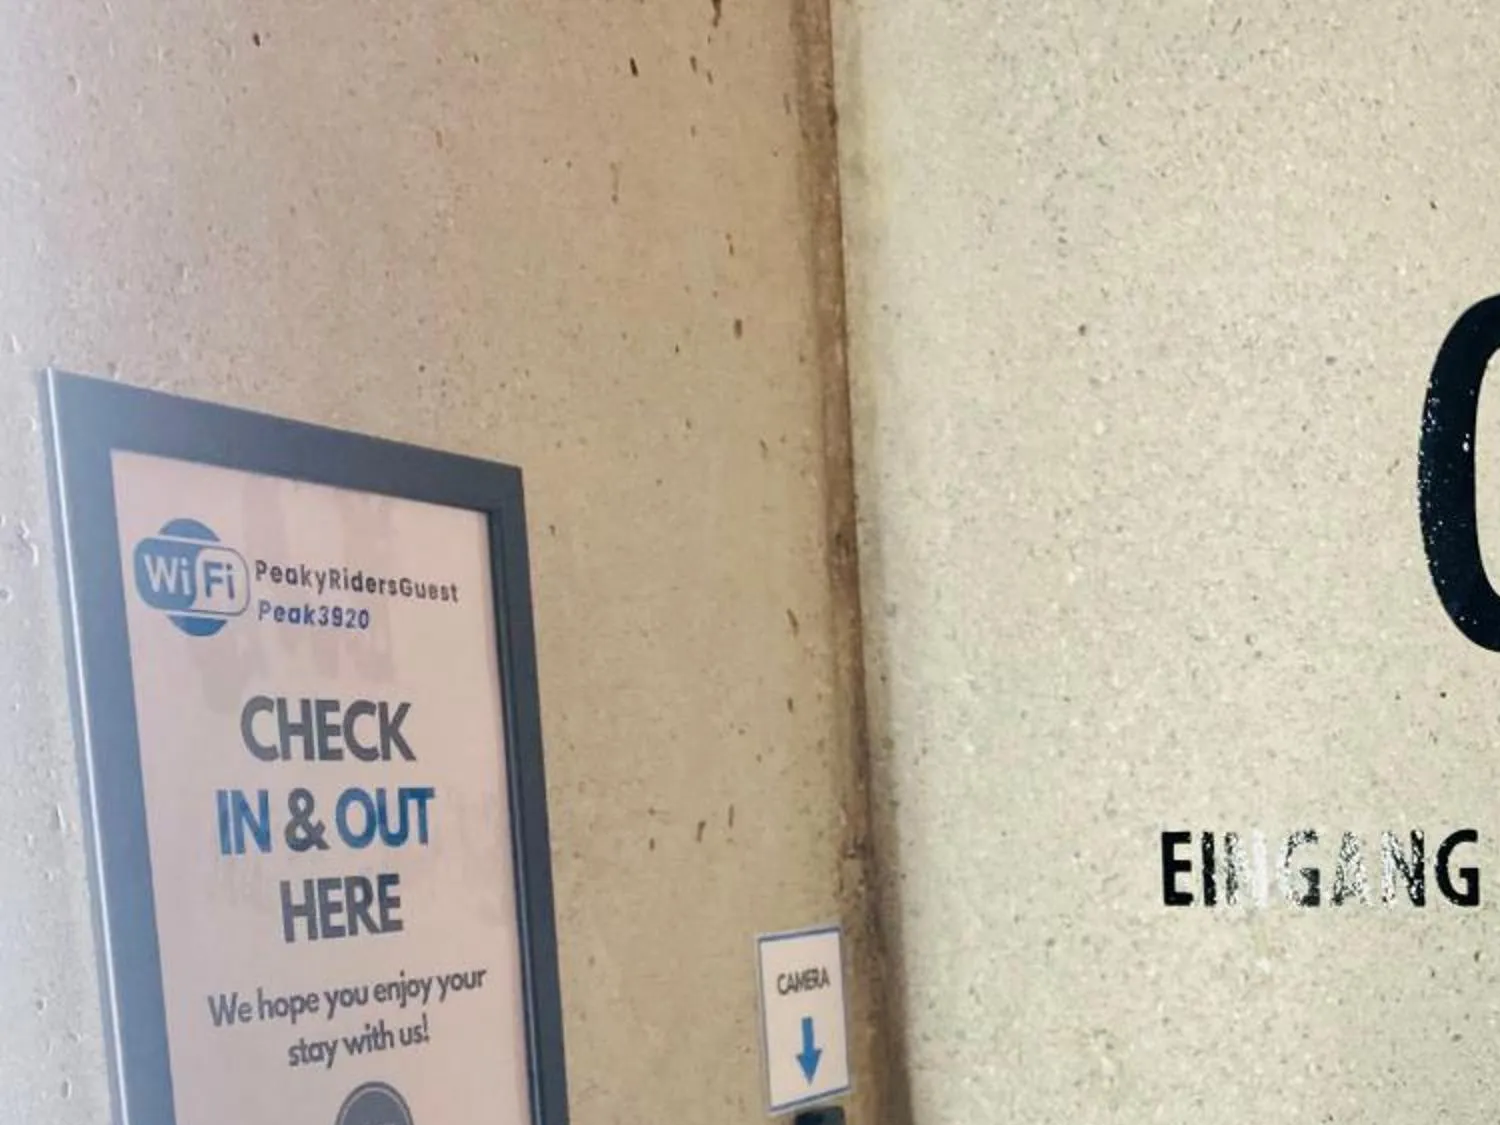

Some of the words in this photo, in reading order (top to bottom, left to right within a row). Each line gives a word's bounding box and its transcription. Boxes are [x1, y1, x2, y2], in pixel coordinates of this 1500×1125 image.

[144, 554, 235, 600] WiFi
[255, 559, 460, 603] PeakyRidersGuest
[258, 600, 370, 630] Peak3920
[240, 695, 416, 762] CHECK
[217, 789, 272, 854] IN
[285, 789, 330, 852] &
[335, 787, 435, 850] OUT
[280, 873, 403, 943] HERE
[207, 992, 252, 1027] We
[257, 987, 320, 1025] hope
[324, 986, 368, 1020] you
[374, 970, 433, 1008] enjoy
[437, 969, 487, 1003] your
[777, 967, 830, 996] CAMERA
[288, 1038, 338, 1069] stay
[342, 1019, 394, 1056] with
[399, 1013, 430, 1047] us!
